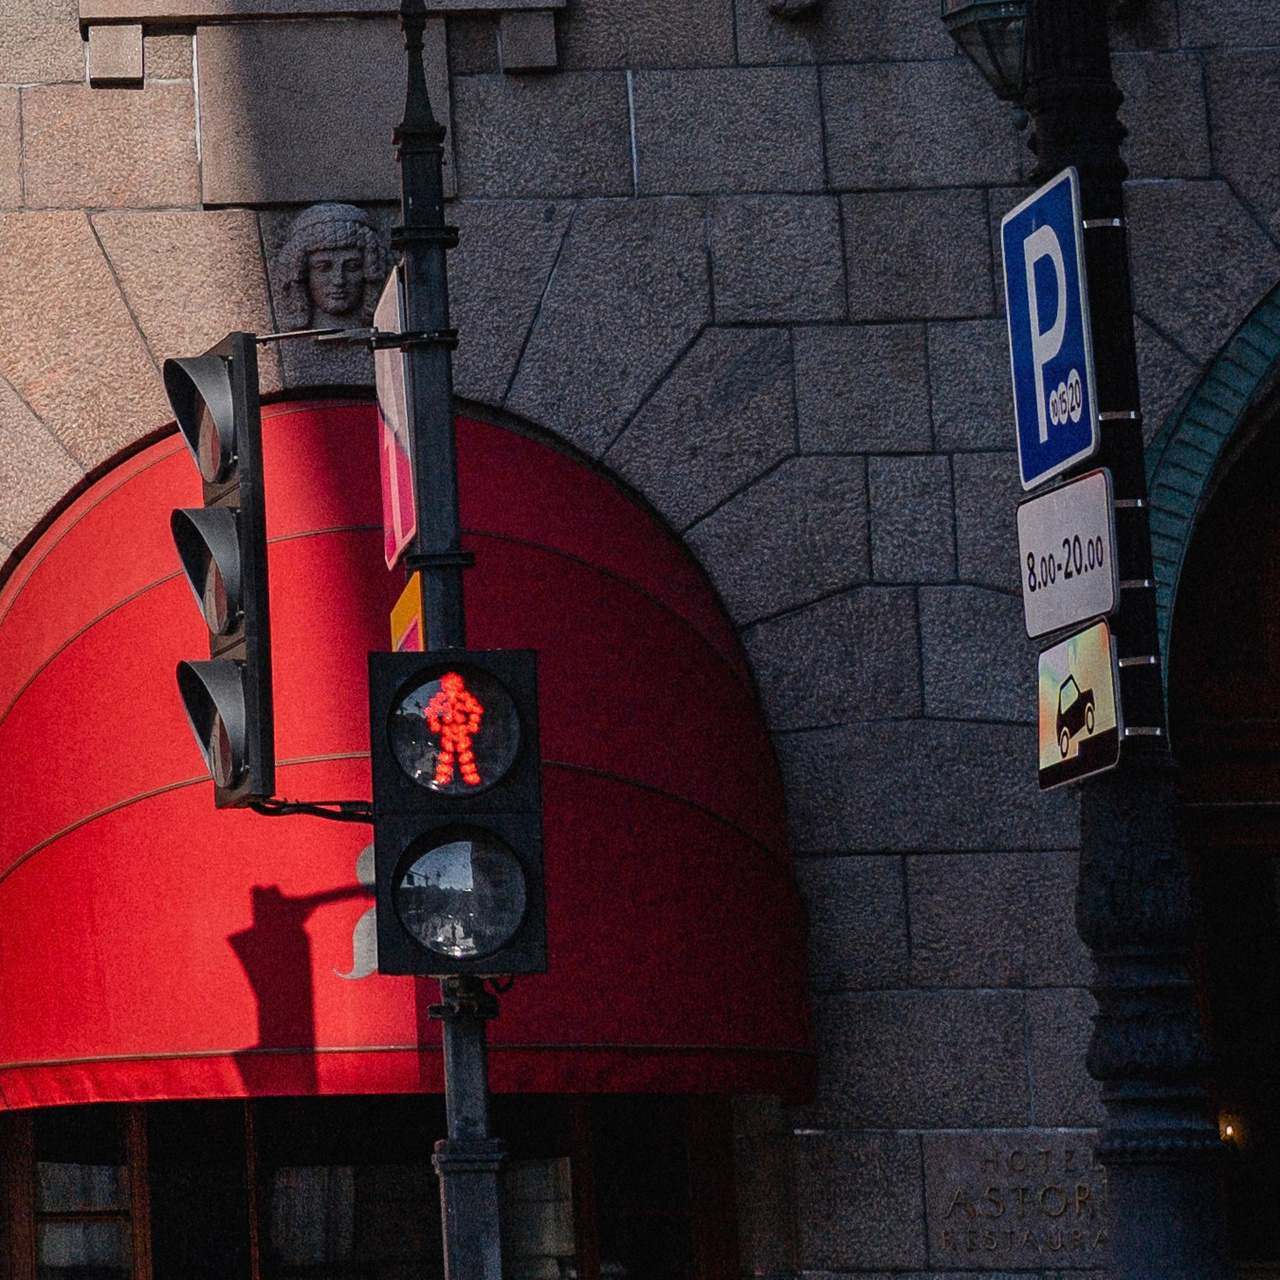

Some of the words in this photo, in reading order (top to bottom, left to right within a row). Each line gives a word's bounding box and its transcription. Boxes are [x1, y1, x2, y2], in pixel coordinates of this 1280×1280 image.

[1023, 224, 1067, 444] P
[1069, 379, 1080, 413] 20
[1027, 534, 1104, 593] 8.00-20.00
